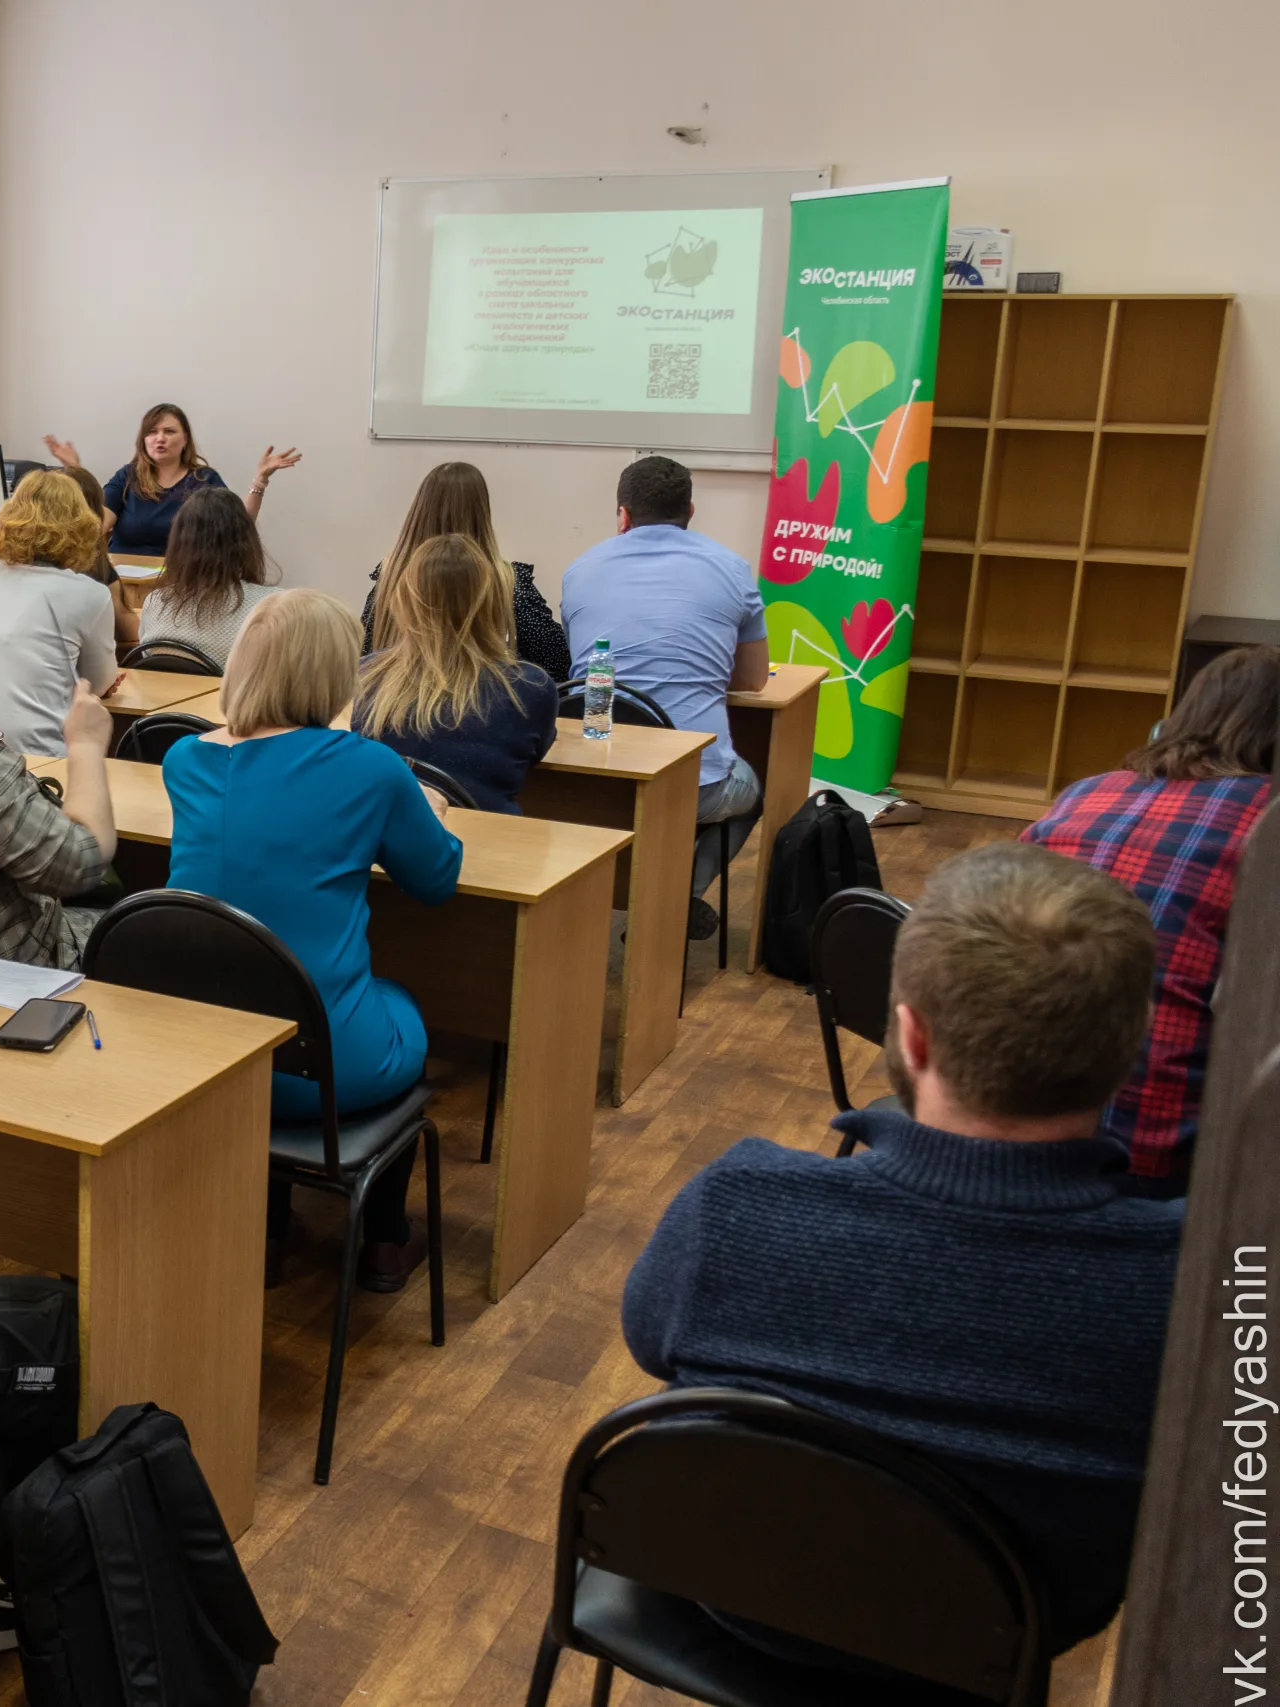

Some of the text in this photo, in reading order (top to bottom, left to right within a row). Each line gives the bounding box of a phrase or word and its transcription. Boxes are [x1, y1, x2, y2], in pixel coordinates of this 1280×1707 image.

[521, 244, 589, 254] особенности
[539, 256, 605, 267] конкурсных
[493, 266, 574, 277] испытаний для
[799, 267, 916, 291] ЭКОСТАНЦИЯ
[485, 291, 524, 299] рамках
[527, 289, 588, 298] областного
[521, 301, 575, 309] школьных
[545, 312, 589, 321] детских
[616, 305, 735, 323] ЭКОСТАНЦИЯ
[492, 323, 569, 331] экологических
[494, 333, 566, 342] объединений
[774, 519, 853, 544] ДРУЖИМ
[772, 546, 883, 579] С ПРИРОДОЙ!
